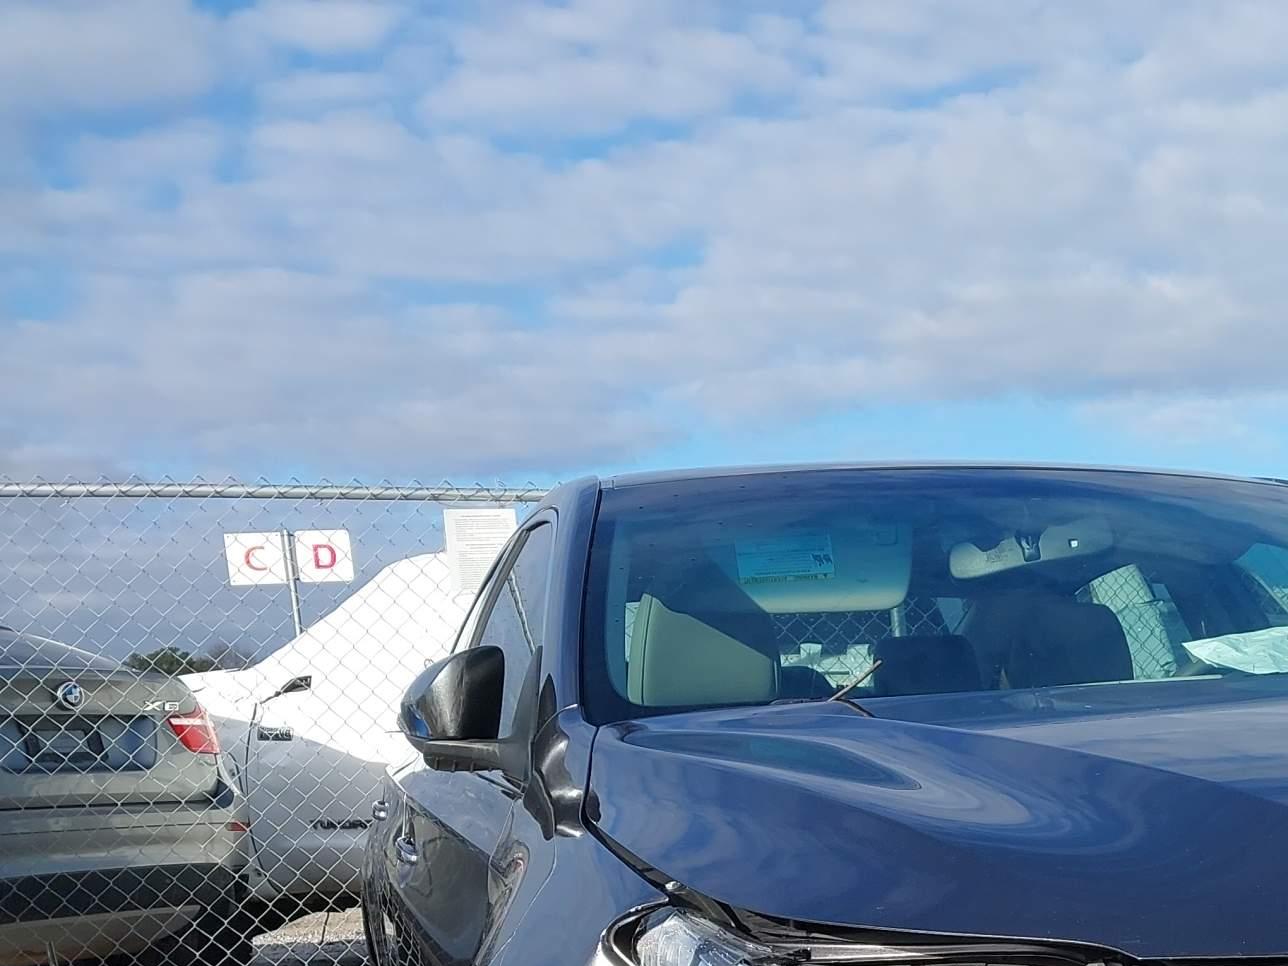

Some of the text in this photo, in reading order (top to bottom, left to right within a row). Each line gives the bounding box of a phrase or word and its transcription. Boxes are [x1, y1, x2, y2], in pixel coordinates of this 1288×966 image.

[244, 545, 268, 571] C
[312, 543, 337, 569] D
[143, 700, 180, 711] X6
